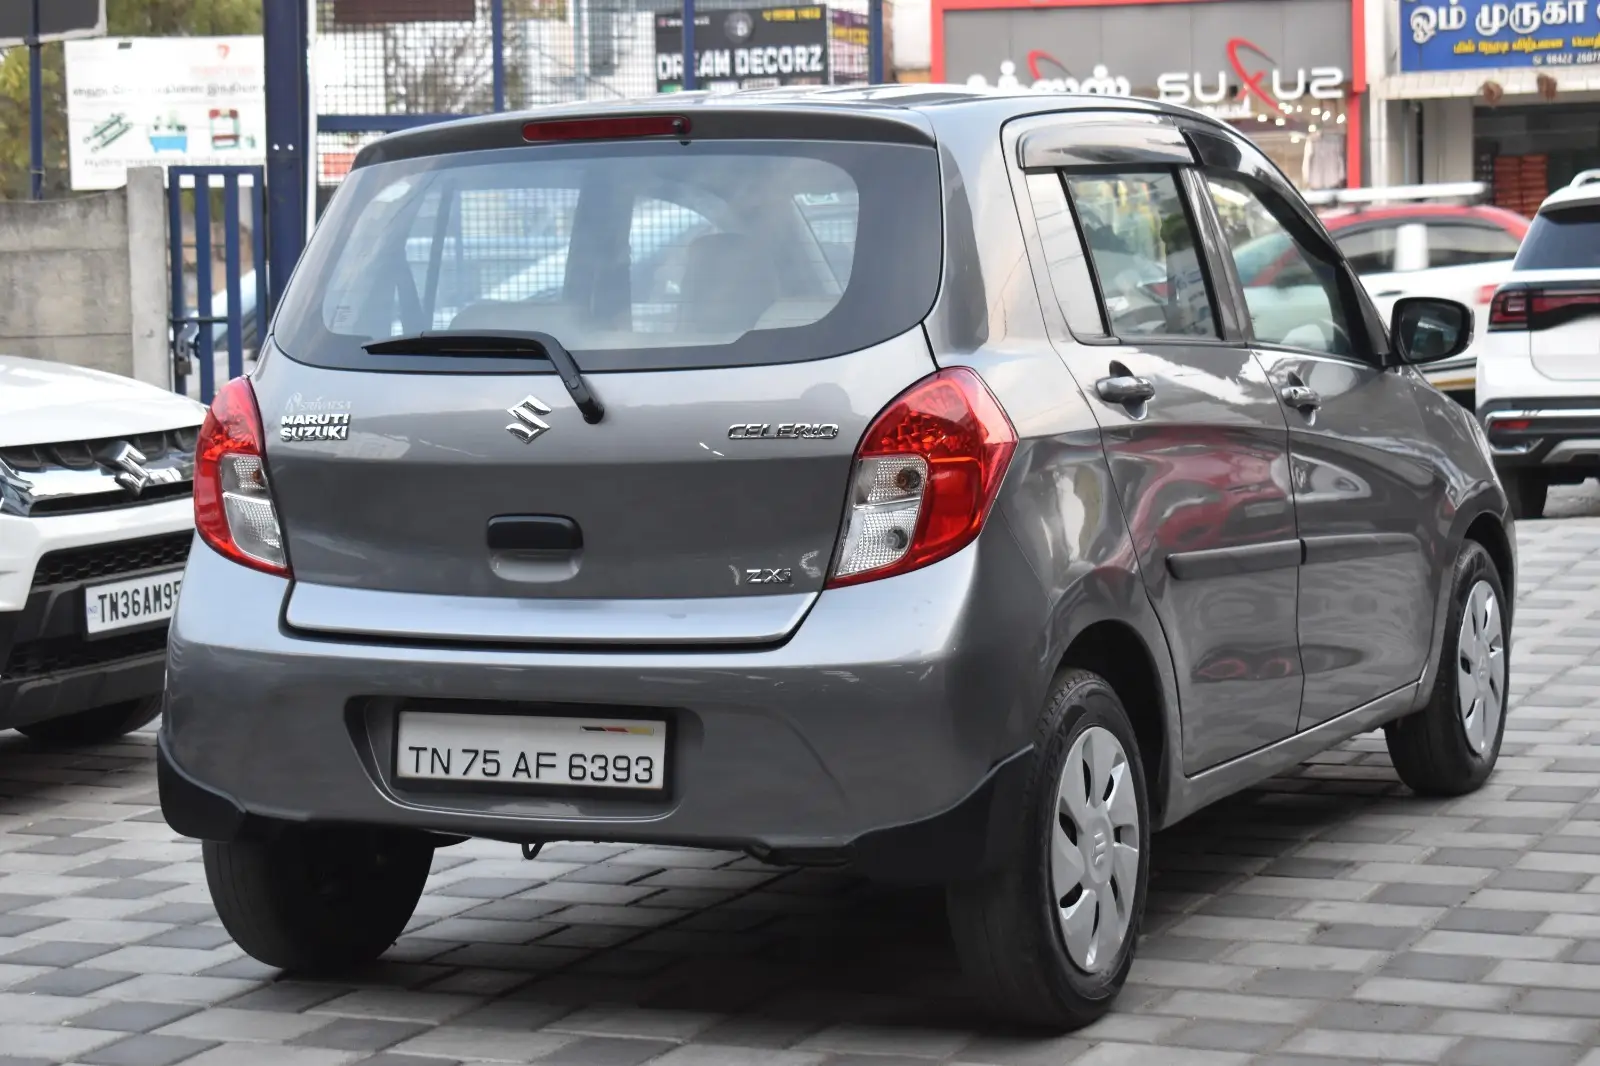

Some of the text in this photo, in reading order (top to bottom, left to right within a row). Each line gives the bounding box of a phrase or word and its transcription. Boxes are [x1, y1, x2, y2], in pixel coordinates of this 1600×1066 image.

[1475, 0, 1588, 37] முருகா
[735, 43, 825, 76] DECORZ
[279, 426, 349, 442] SUZUKI
[727, 422, 840, 440] CELERIO
[408, 745, 654, 784] TN 75 AF 6393
